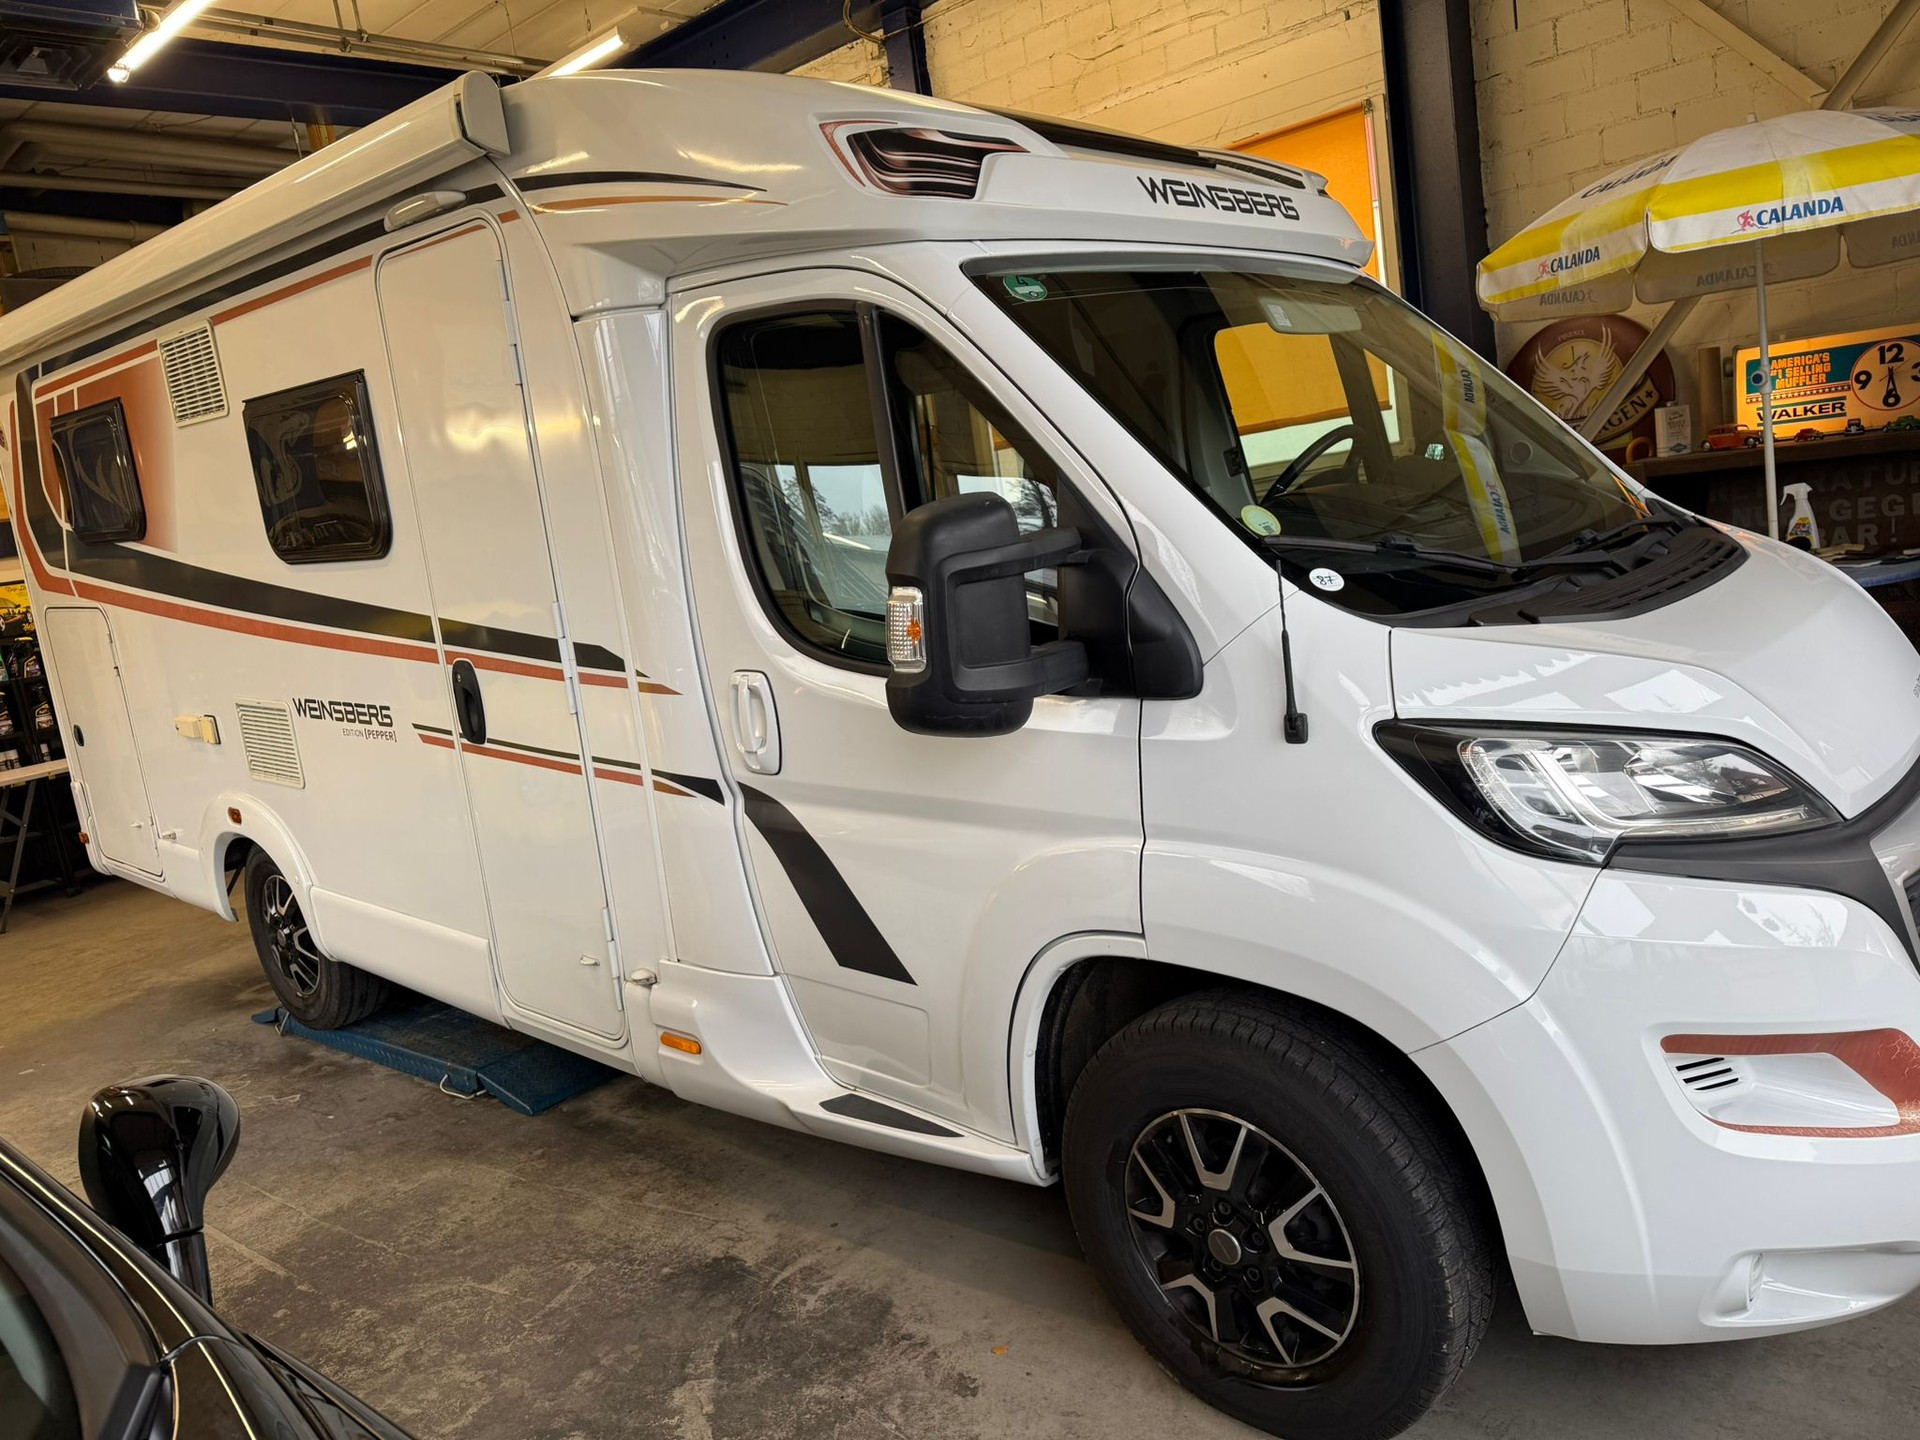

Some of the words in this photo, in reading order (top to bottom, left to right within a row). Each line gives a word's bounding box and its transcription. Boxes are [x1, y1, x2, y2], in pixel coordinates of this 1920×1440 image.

[1136, 175, 1300, 220] WEINSBERG
[1756, 196, 1844, 226] CALANDA
[1550, 246, 1600, 273] CALANDA
[1770, 352, 1831, 370] AMERICA'S
[1877, 343, 1904, 365] 12
[1769, 369, 1783, 379] #1
[1785, 362, 1831, 378] SELLING
[1854, 370, 1872, 390] 9
[1775, 373, 1827, 390] MUFFLER
[1882, 387, 1901, 408] 6
[1316, 575, 1334, 586] 87
[292, 697, 394, 728] WEINSBERG
[342, 728, 364, 738] EDITION
[364, 728, 397, 742] [PEPPER]
